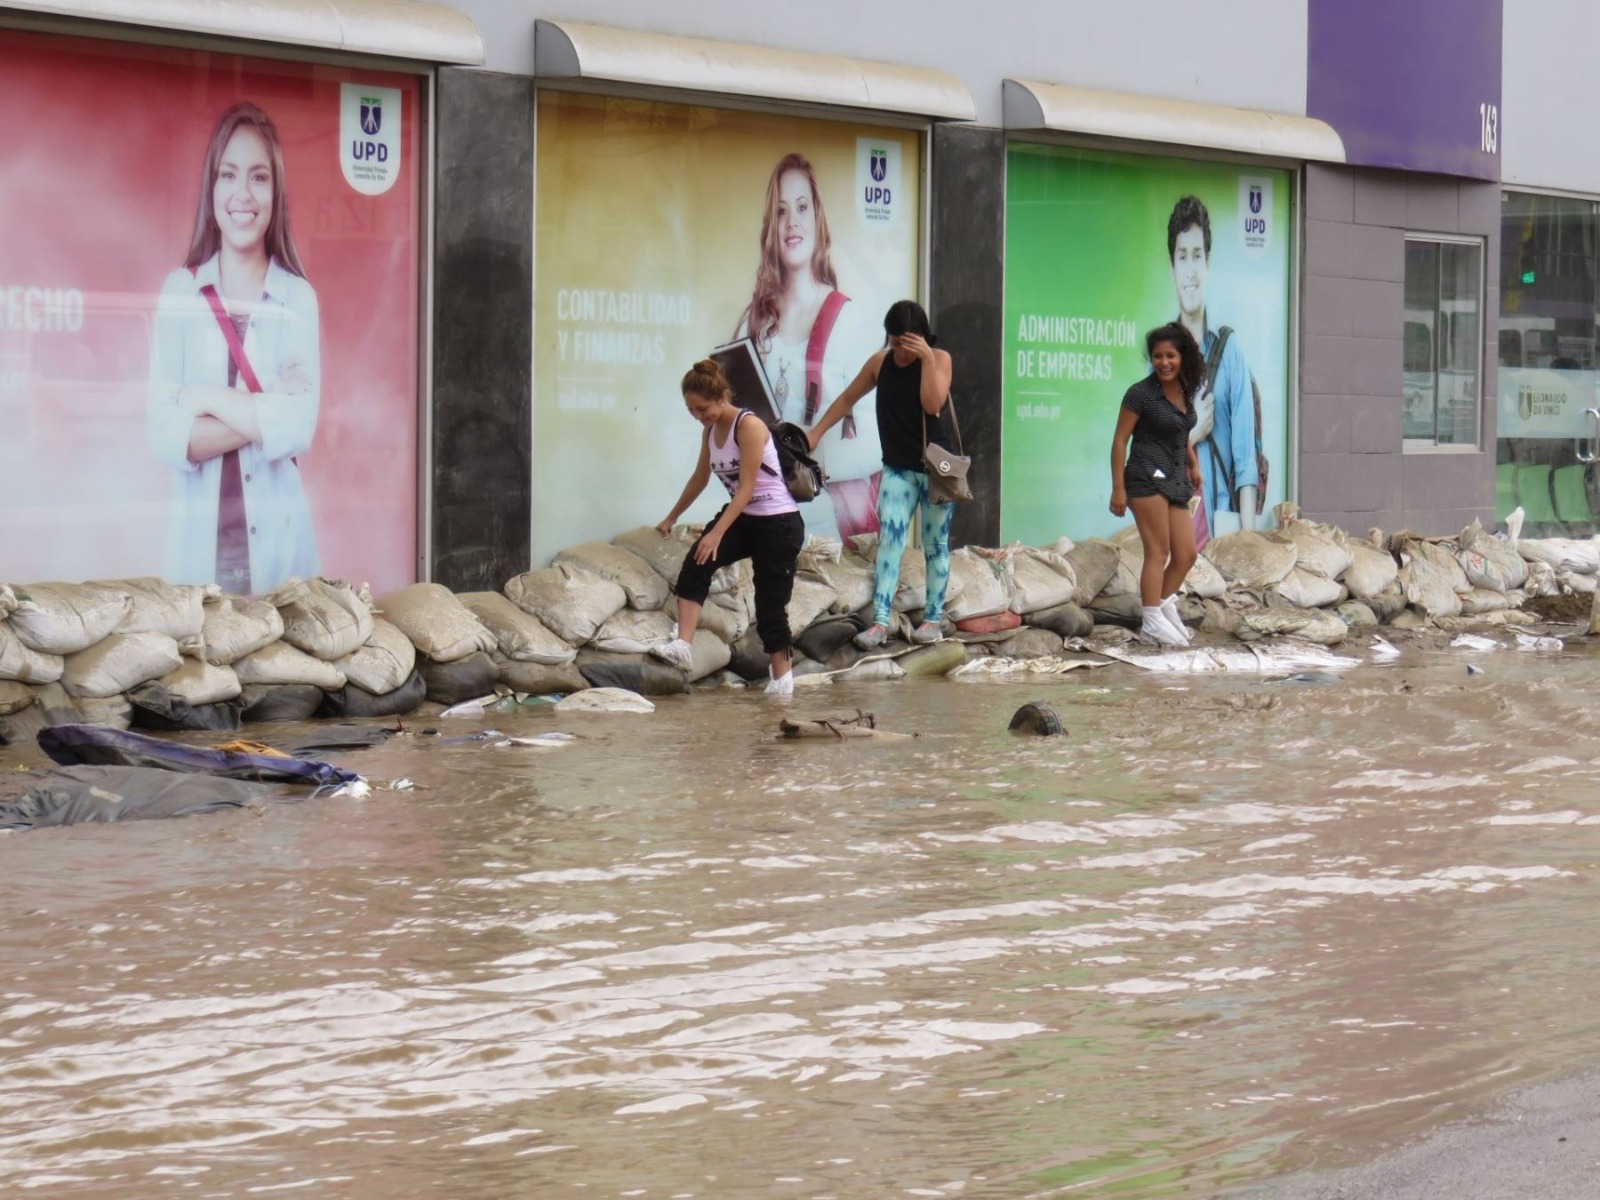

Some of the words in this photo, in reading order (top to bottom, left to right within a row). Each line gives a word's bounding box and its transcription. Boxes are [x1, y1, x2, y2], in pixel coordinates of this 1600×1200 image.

[1480, 103, 1497, 154] 163
[353, 141, 388, 162] UPD
[865, 186, 891, 205] UPD
[1245, 218, 1265, 234] UPD
[557, 289, 691, 324] CONTABILIDAD
[1018, 314, 1136, 347] ADMINISTRACIÓN
[557, 330, 569, 361] Y
[574, 331, 664, 364] FINANZAS
[1017, 350, 1034, 378] DE
[1038, 351, 1112, 380] EMPRESAS
